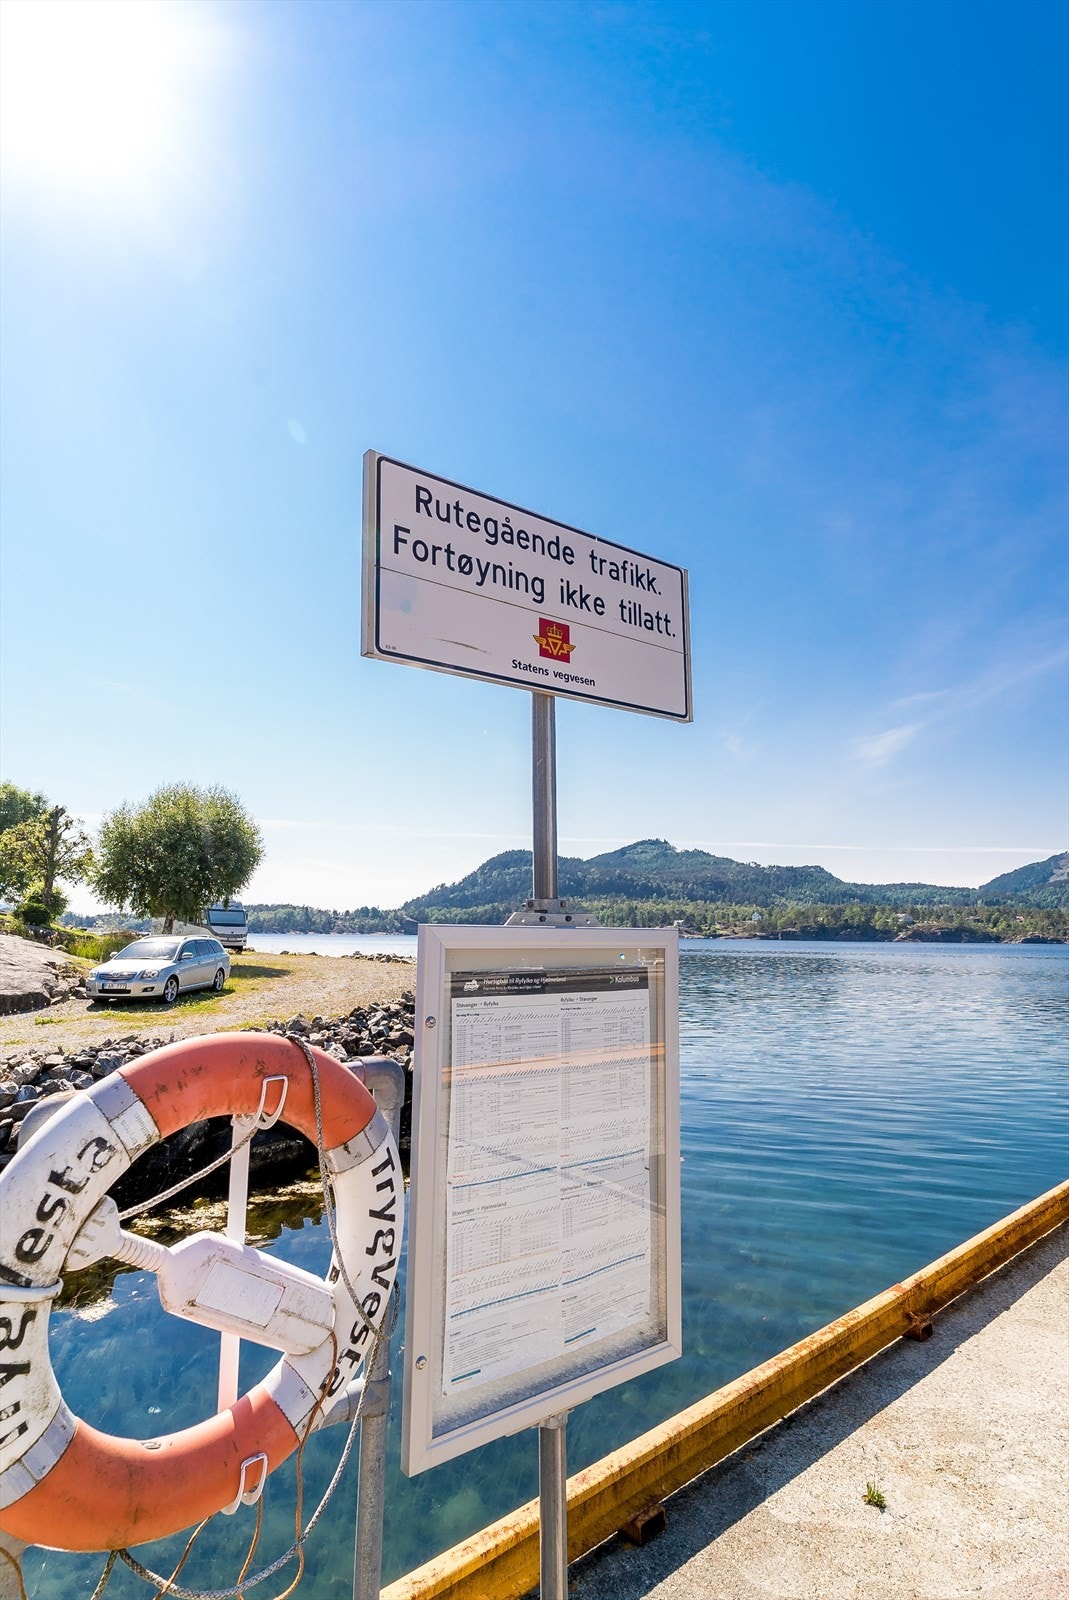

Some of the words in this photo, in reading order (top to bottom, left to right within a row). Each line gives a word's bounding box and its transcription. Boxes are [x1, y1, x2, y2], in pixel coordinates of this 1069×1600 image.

[393, 524, 545, 604] Fortøyning
[560, 578, 606, 616] ikke
[619, 598, 676, 638] tillatt.
[415, 484, 576, 566] Rutegående
[589, 549, 662, 596] trafikk.
[512, 659, 549, 676] Statens
[553, 670, 596, 687] vegvesen
